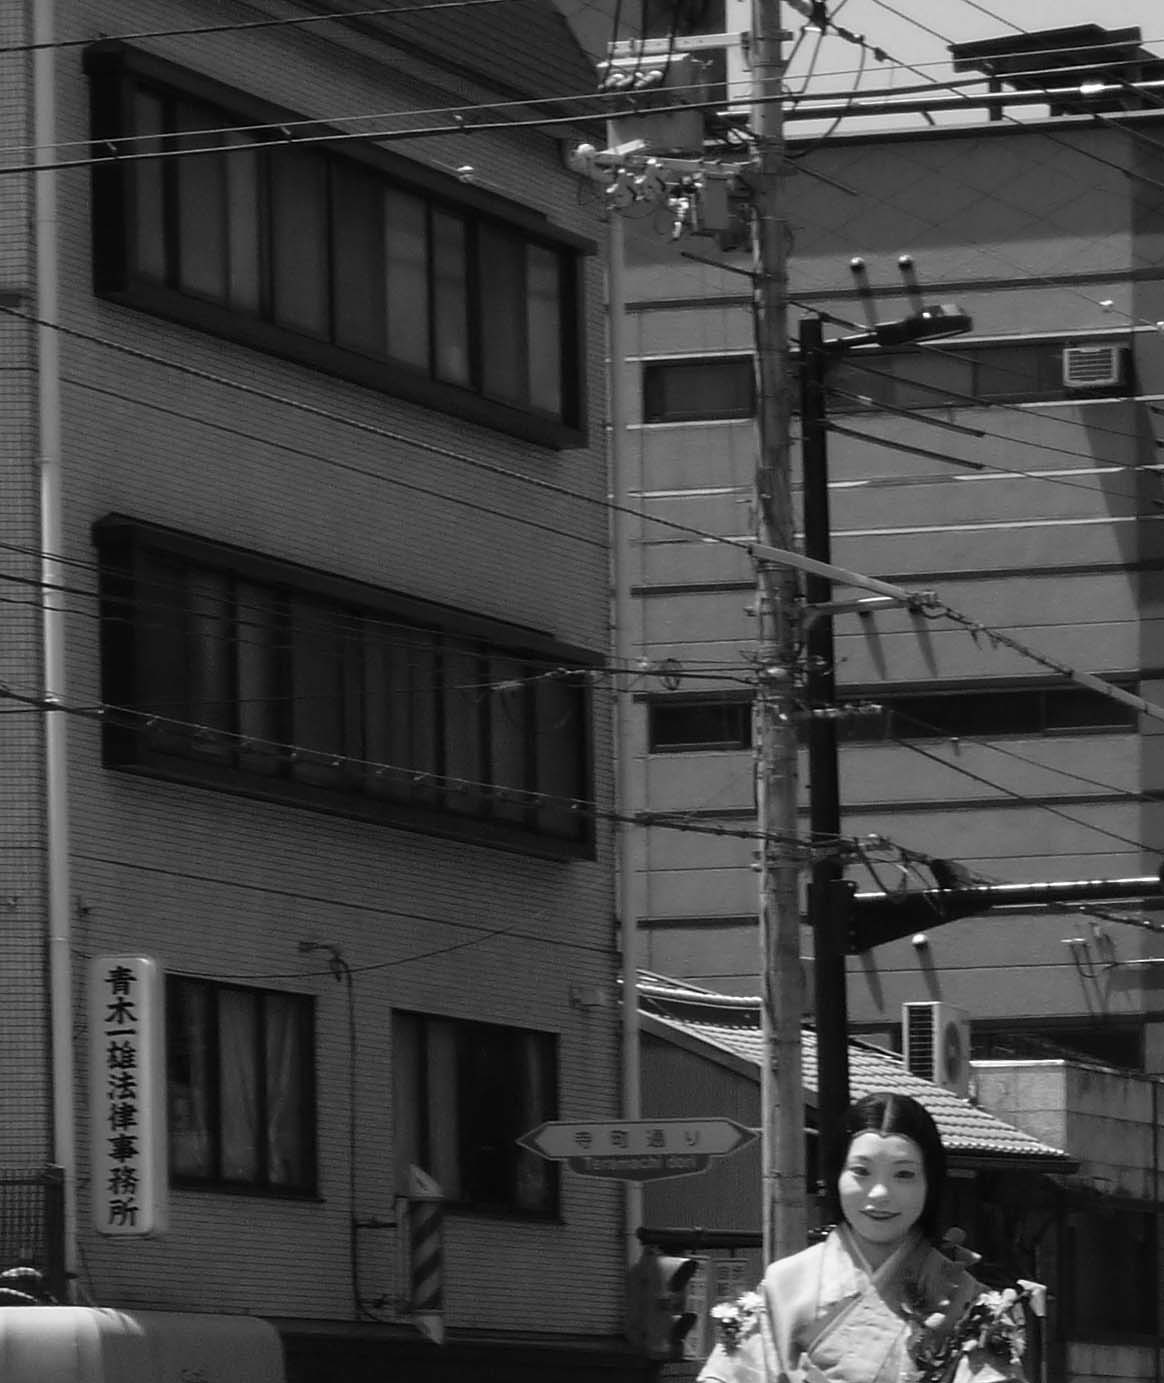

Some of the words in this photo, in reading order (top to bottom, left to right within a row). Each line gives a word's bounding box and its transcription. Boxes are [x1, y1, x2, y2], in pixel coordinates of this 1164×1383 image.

[104, 965, 140, 1227] 青木一雄法律事務所
